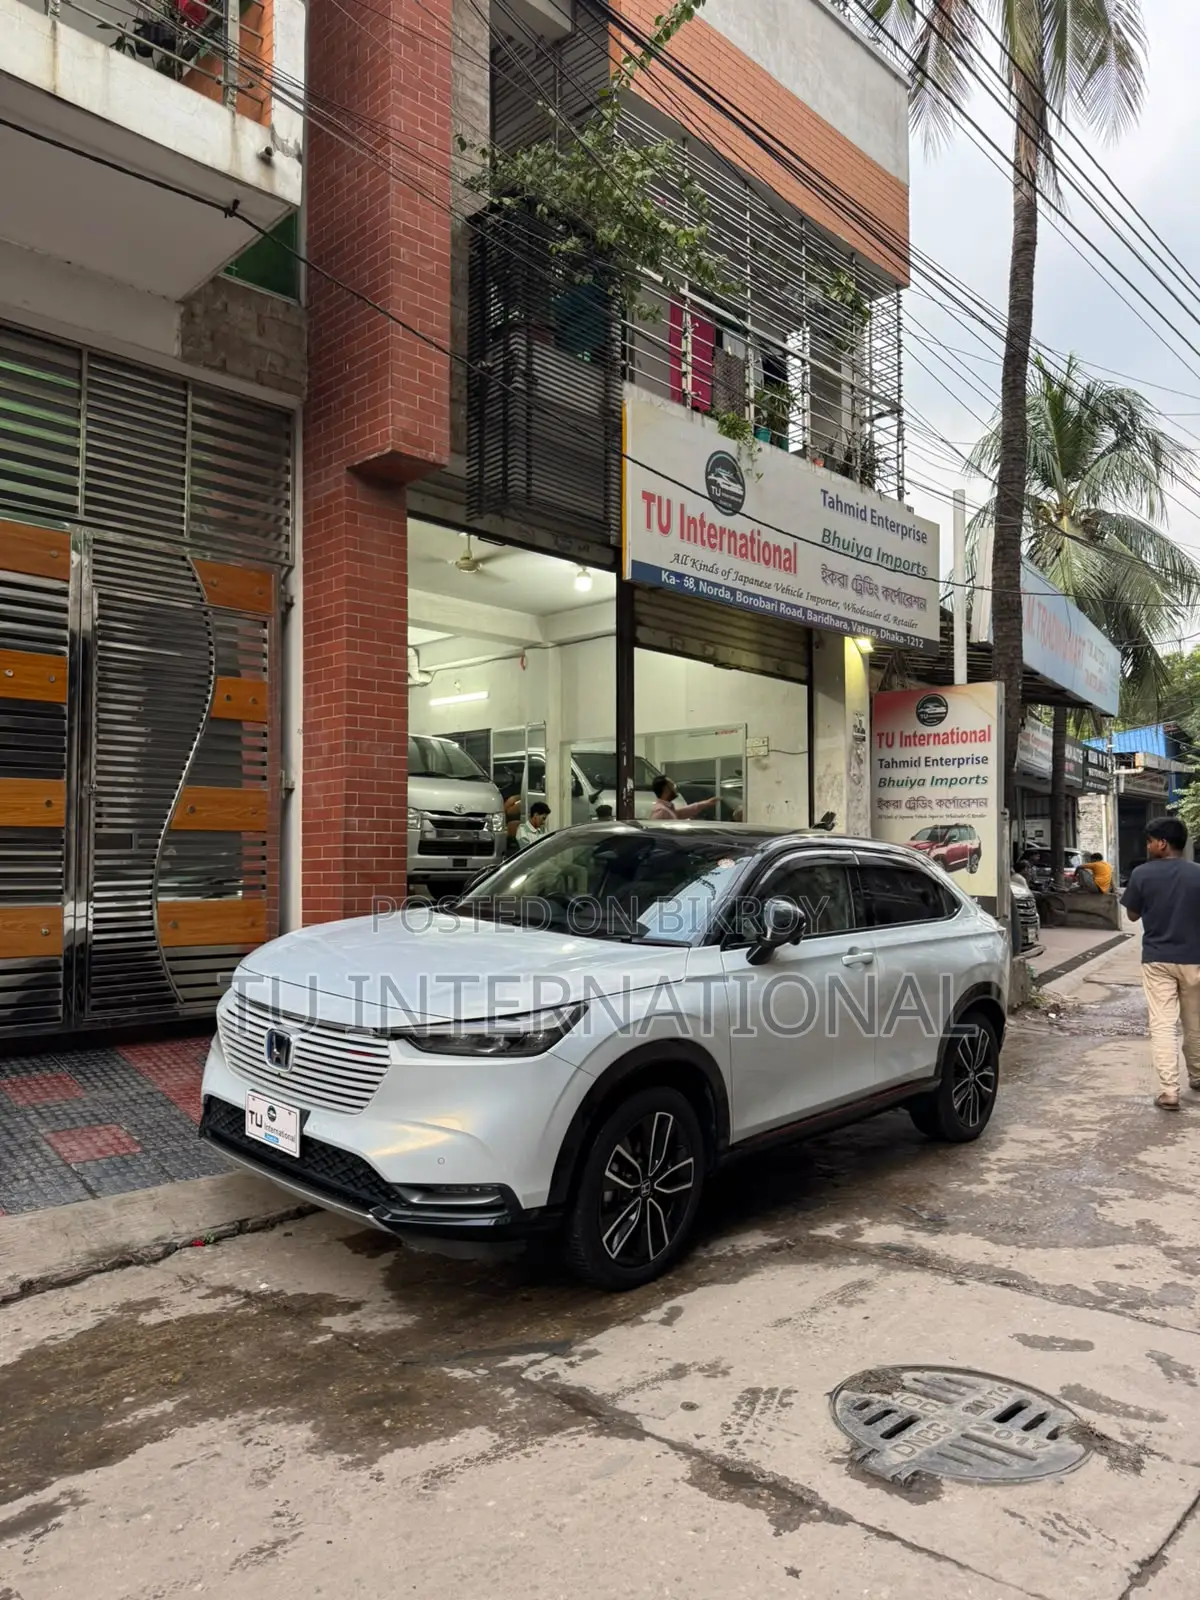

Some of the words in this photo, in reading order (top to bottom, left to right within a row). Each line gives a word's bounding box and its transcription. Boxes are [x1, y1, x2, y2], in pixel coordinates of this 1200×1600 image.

[711, 486, 722, 497] TU
[641, 490, 672, 536] TU
[679, 503, 798, 575] International
[821, 489, 867, 522] Tahmid
[870, 508, 928, 544] Enterprise
[821, 528, 872, 558] Bhuiya
[877, 547, 928, 577] Imports
[670, 553, 688, 566] All
[690, 557, 719, 575] Kinds
[721, 567, 734, 580] of
[733, 570, 773, 591] Japanese
[773, 581, 805, 600] Vehicle
[805, 591, 841, 610] Importer,
[843, 601, 882, 621] Wholesaler
[892, 616, 919, 630] Retailer
[820, 563, 849, 591] ইকরা
[851, 574, 880, 601] ট্রেডিং
[661, 570, 681, 585] Ka-
[699, 581, 734, 603] Norda,
[736, 591, 779, 613] Borobari
[779, 602, 806, 621] Road,
[806, 610, 850, 632] Baridhara,
[851, 621, 880, 640] Vatara,
[880, 628, 925, 649] Dhaka-1212
[876, 732, 895, 750] TU
[899, 724, 991, 749] International
[878, 756, 921, 770] Tahmid
[924, 754, 989, 770] Enterprise
[878, 775, 926, 791] Bhuiya
[930, 774, 988, 789] Imports
[248, 1110, 263, 1128] TU
[263, 1121, 297, 1144] International
[889, 1421, 953, 1458] DNCC
